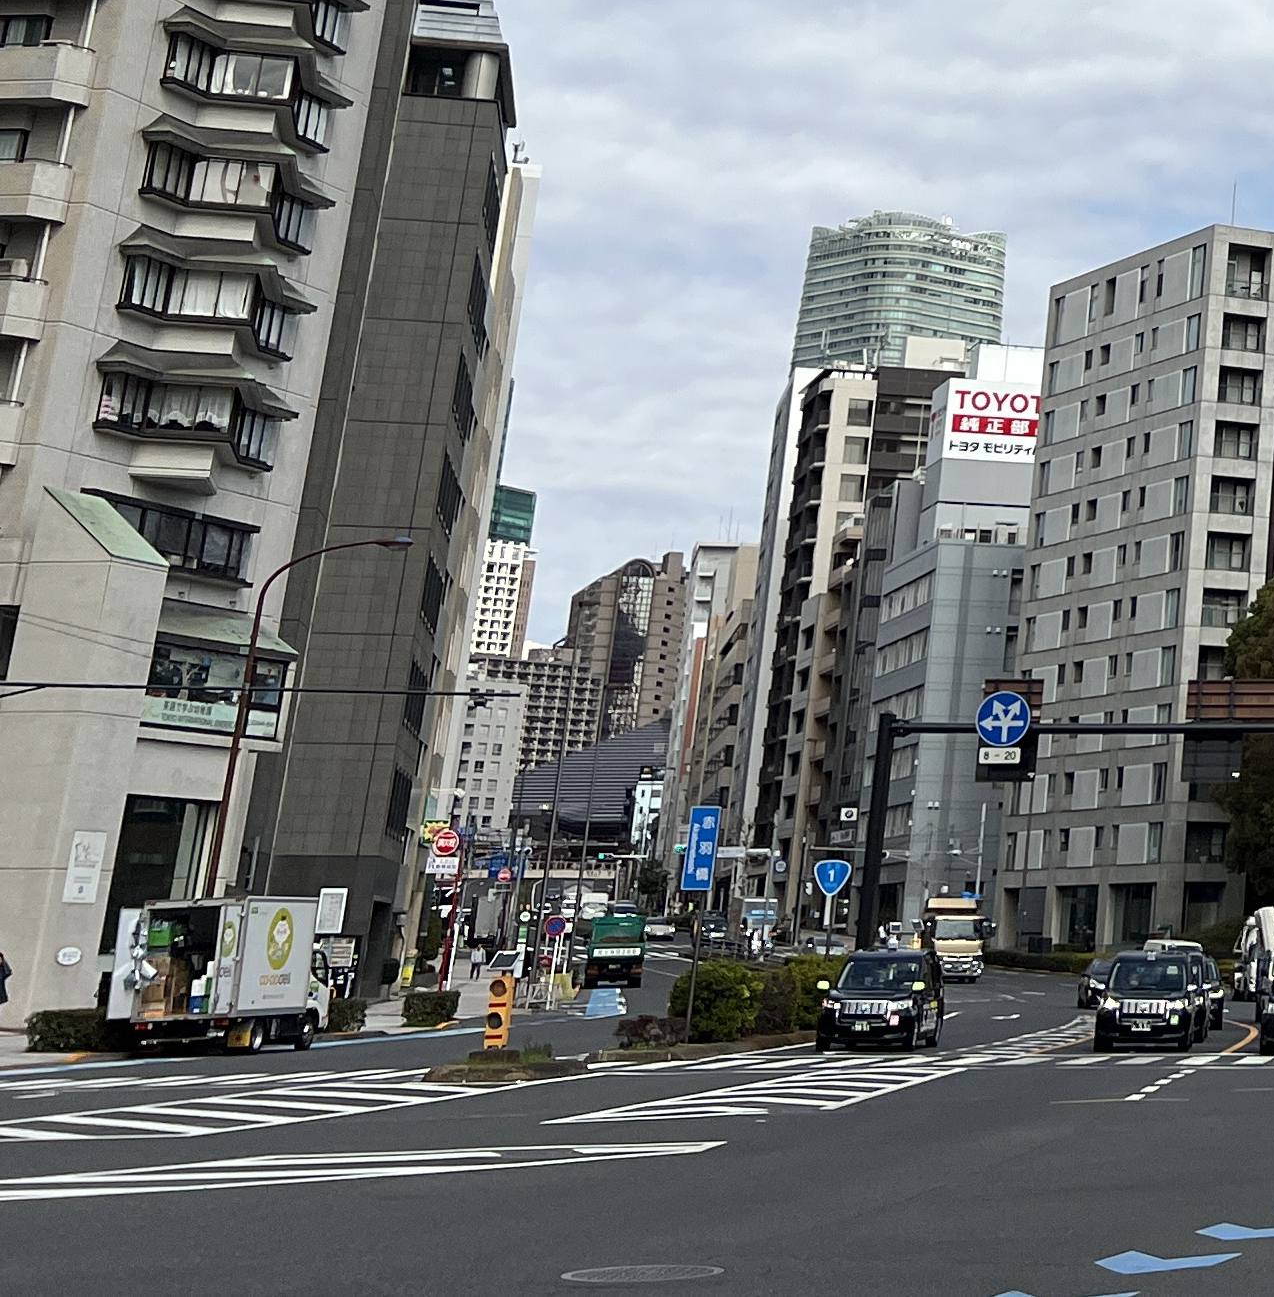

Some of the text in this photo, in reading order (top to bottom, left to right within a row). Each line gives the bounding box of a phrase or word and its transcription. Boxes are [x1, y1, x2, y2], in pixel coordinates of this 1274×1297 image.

[959, 416, 1038, 436] 純正部
[983, 442, 1037, 456] モビリティ
[828, 869, 835, 882] 1
